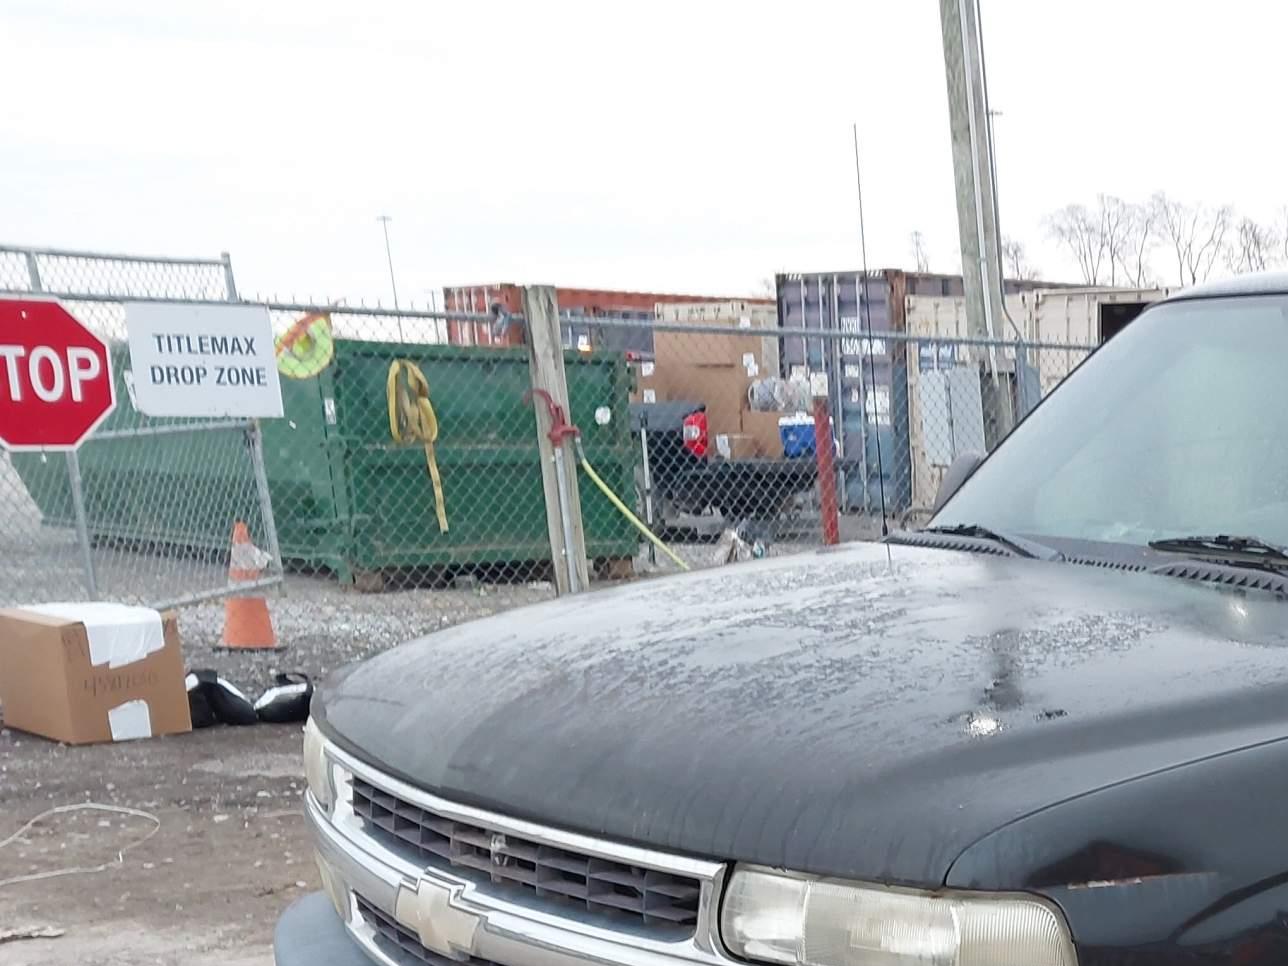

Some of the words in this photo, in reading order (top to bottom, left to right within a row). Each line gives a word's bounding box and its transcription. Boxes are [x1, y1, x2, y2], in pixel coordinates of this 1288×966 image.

[152, 334, 257, 356] TITLEMAX
[0, 345, 100, 403] TOP
[150, 365, 208, 386] DROP
[215, 366, 268, 387] ZONE
